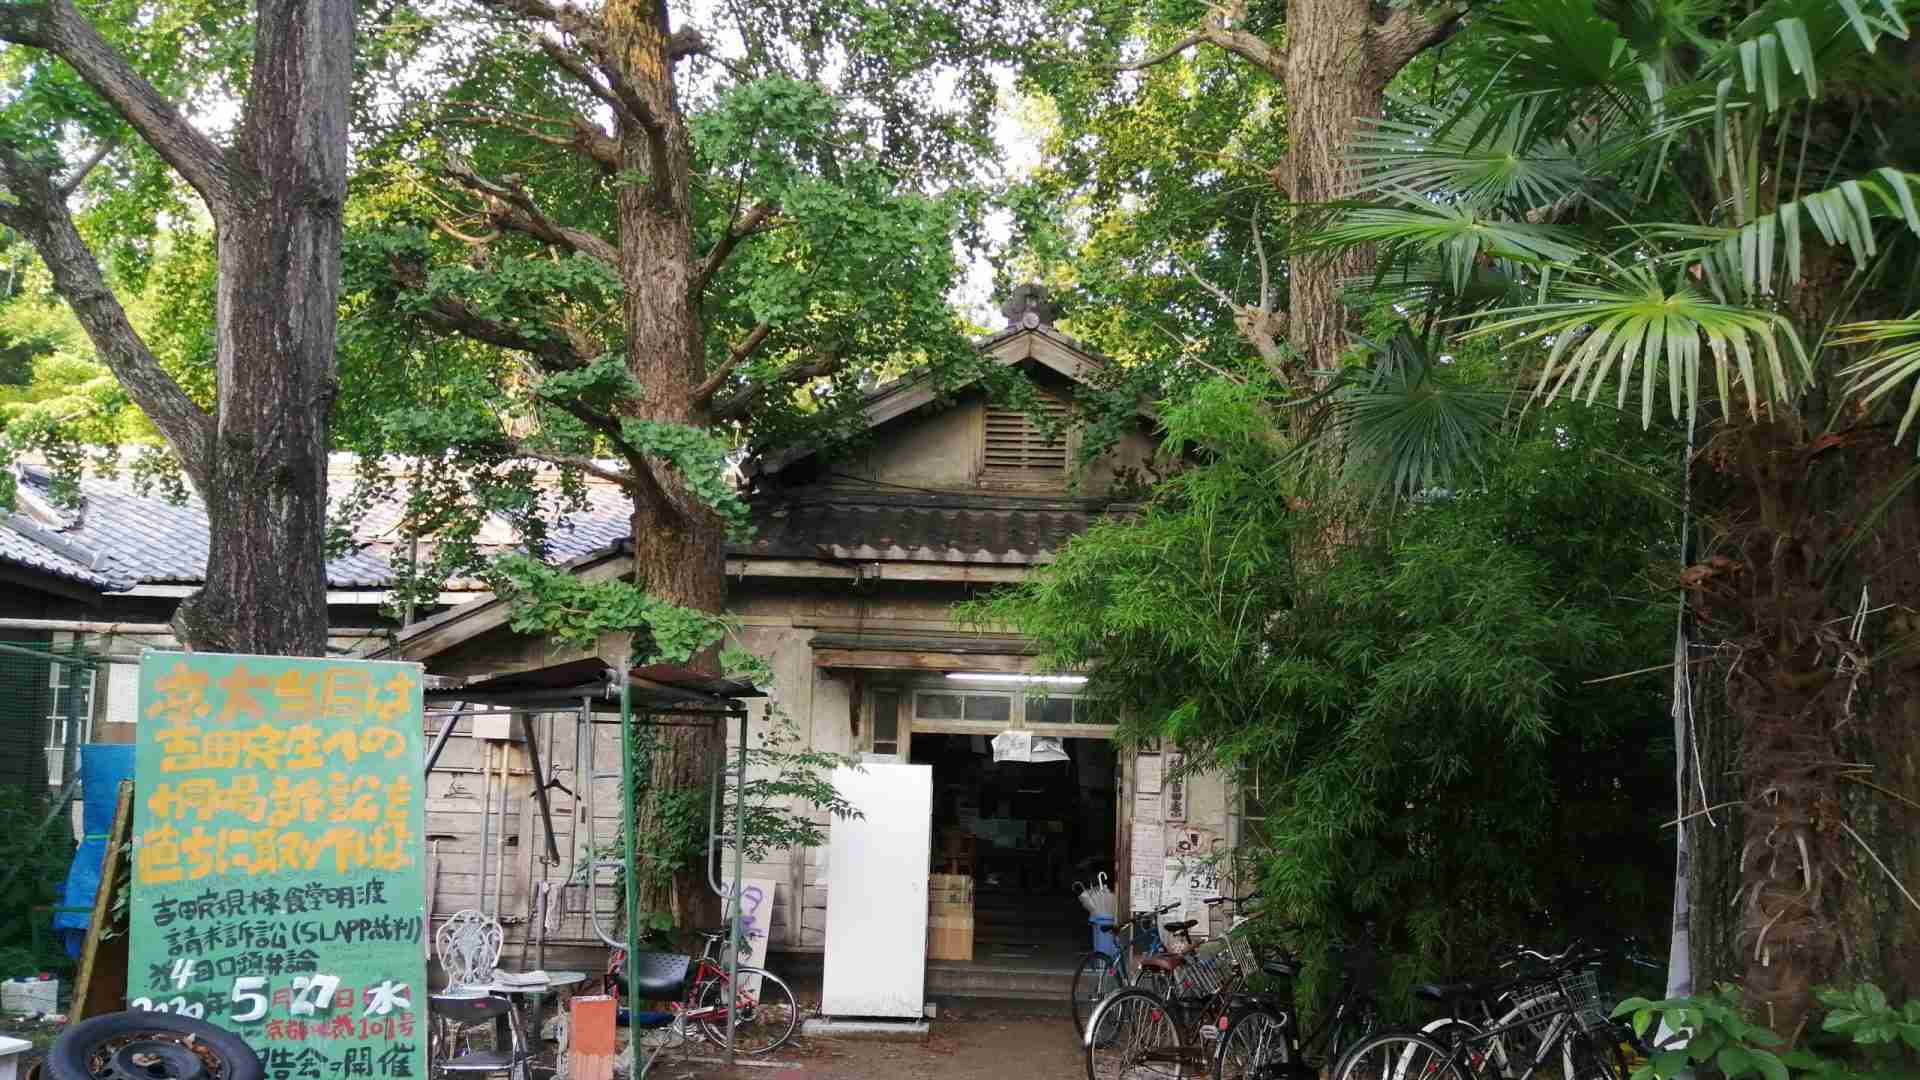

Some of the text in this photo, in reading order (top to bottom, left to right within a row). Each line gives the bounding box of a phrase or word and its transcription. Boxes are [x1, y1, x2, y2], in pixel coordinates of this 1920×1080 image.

[145, 663, 414, 723] 京大当局は
